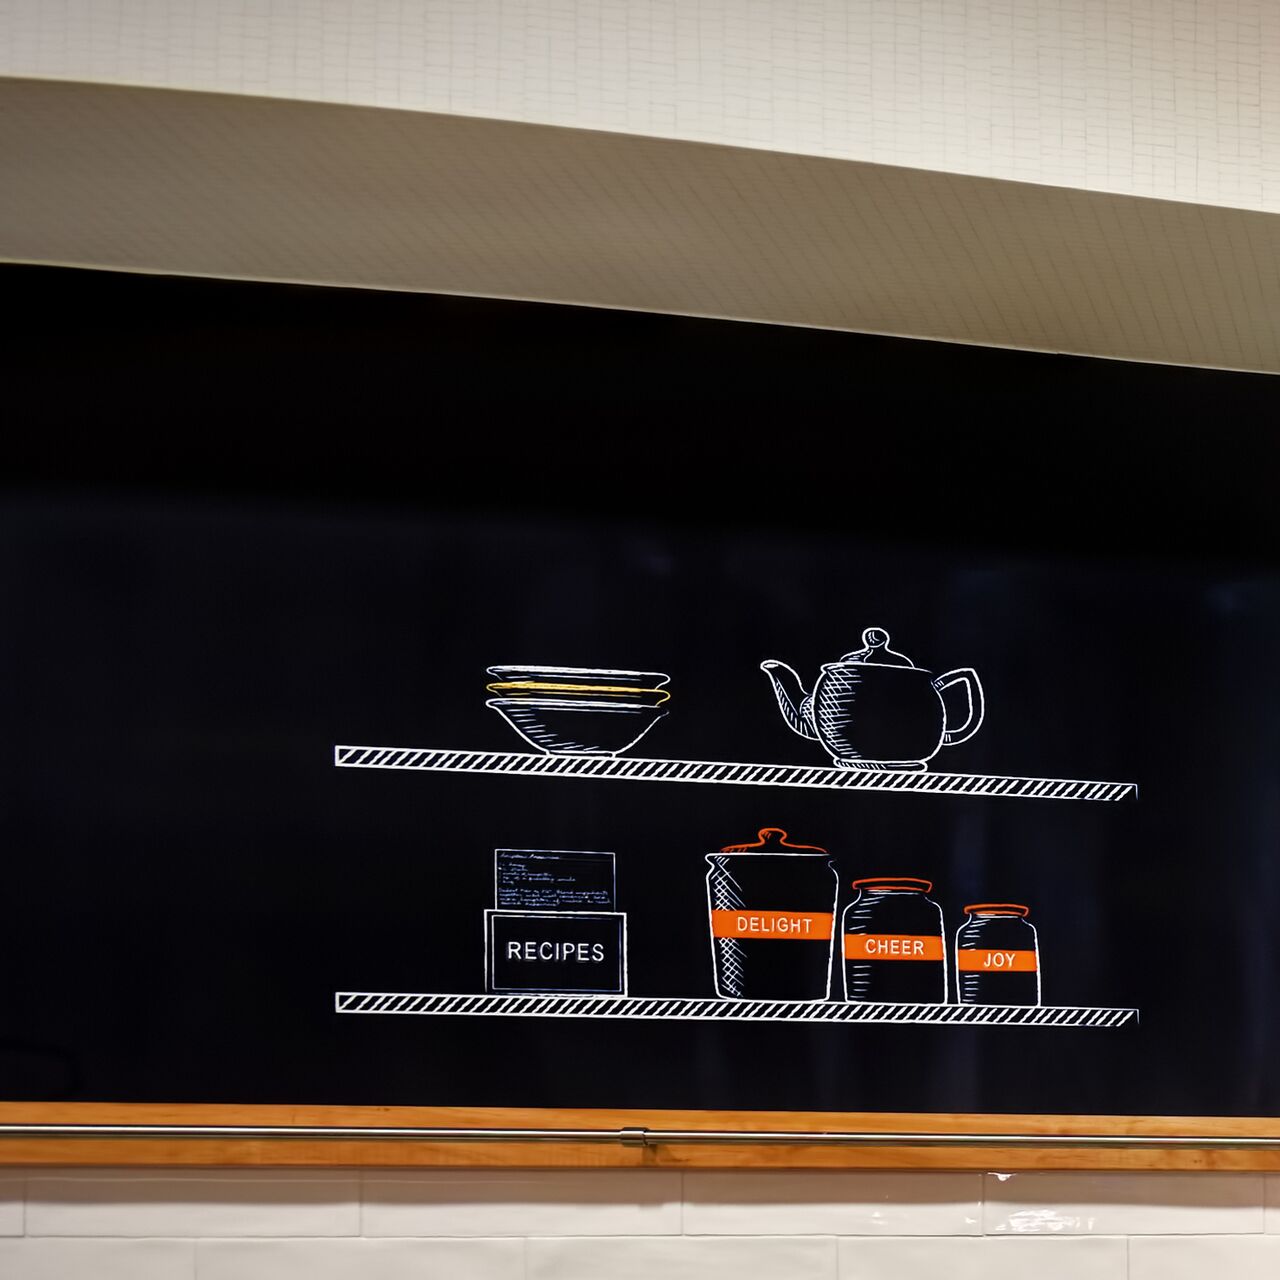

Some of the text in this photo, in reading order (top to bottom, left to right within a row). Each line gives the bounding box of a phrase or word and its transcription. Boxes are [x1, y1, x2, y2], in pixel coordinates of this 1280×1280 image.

[737, 916, 813, 934] DELIGHT
[507, 941, 606, 963] RECIPES
[865, 938, 926, 956] CHEER
[983, 952, 1016, 968] JOY
